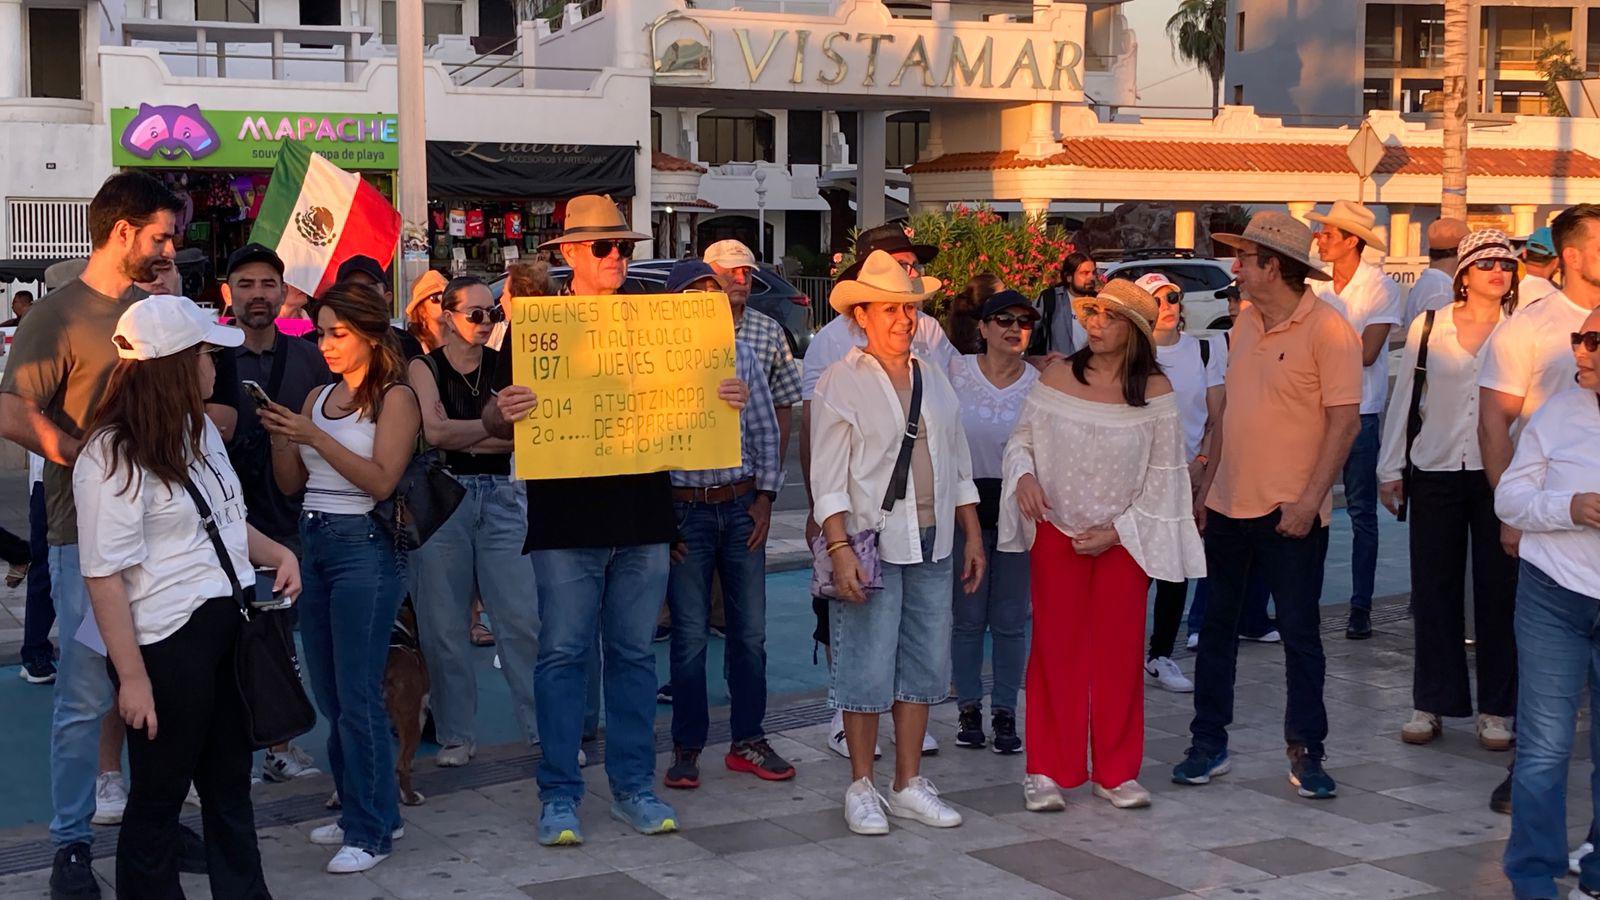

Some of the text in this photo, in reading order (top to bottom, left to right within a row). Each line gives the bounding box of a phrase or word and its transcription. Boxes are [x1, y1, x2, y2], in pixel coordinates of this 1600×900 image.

[732, 28, 1084, 92] VISTAMAR
[237, 116, 398, 142] MAPACHE
[341, 148, 355, 160] de
[357, 148, 385, 162] playa
[516, 302, 599, 325] JOVENES
[612, 301, 639, 322] CON
[522, 332, 559, 353] 1968
[533, 355, 570, 380] 1971
[592, 351, 655, 378] JUEVES
[665, 347, 720, 373] CORPUS
[528, 397, 573, 420] 2014
[595, 441, 613, 457] de
